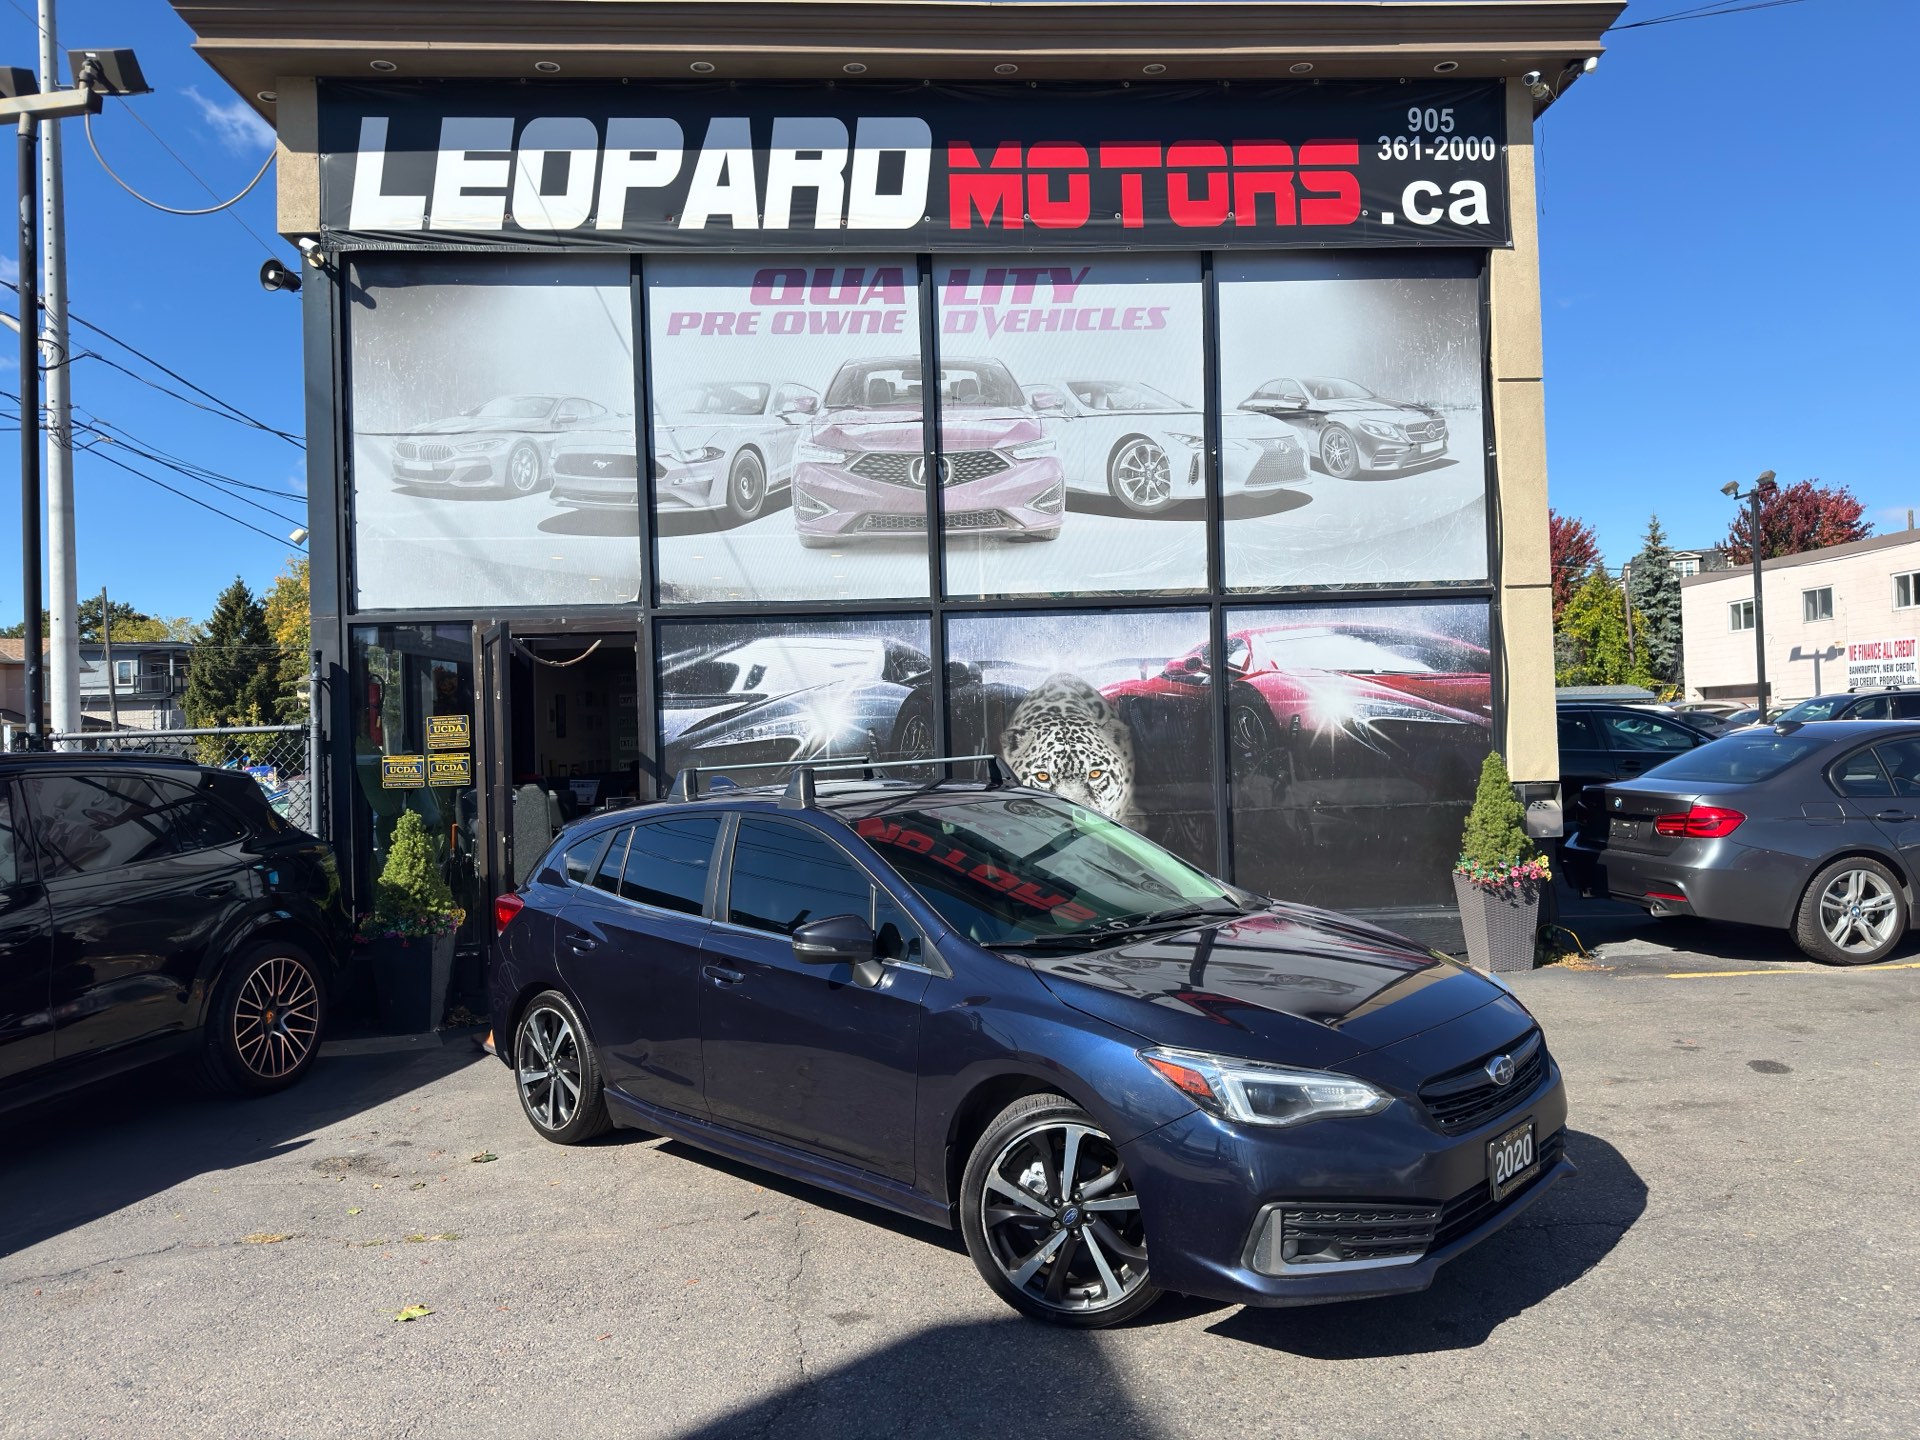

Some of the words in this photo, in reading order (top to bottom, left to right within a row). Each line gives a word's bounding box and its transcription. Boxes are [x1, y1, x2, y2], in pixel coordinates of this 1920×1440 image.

[1407, 107, 1455, 133] 905
[1377, 135, 1496, 161] 361-2000
[349, 116, 933, 231] LEOPARD
[948, 138, 1361, 229] MOTORS
[1381, 180, 1491, 226] .ca
[666, 311, 762, 336] PRE
[1849, 645, 1856, 661] WE
[1859, 643, 1881, 660] FINANCE
[1883, 642, 1893, 660] ALL
[1894, 640, 1915, 658] CREDIT
[1883, 664, 1894, 672] NEW
[1896, 663, 1916, 673] CREDIT,
[1849, 677, 1859, 686] BAD
[1880, 675, 1905, 685] PROPOSAL
[433, 724, 463, 733] UCDA
[389, 766, 418, 774] UCDA
[435, 763, 464, 772] UCDA
[1496, 1133, 1532, 1185] 2020
